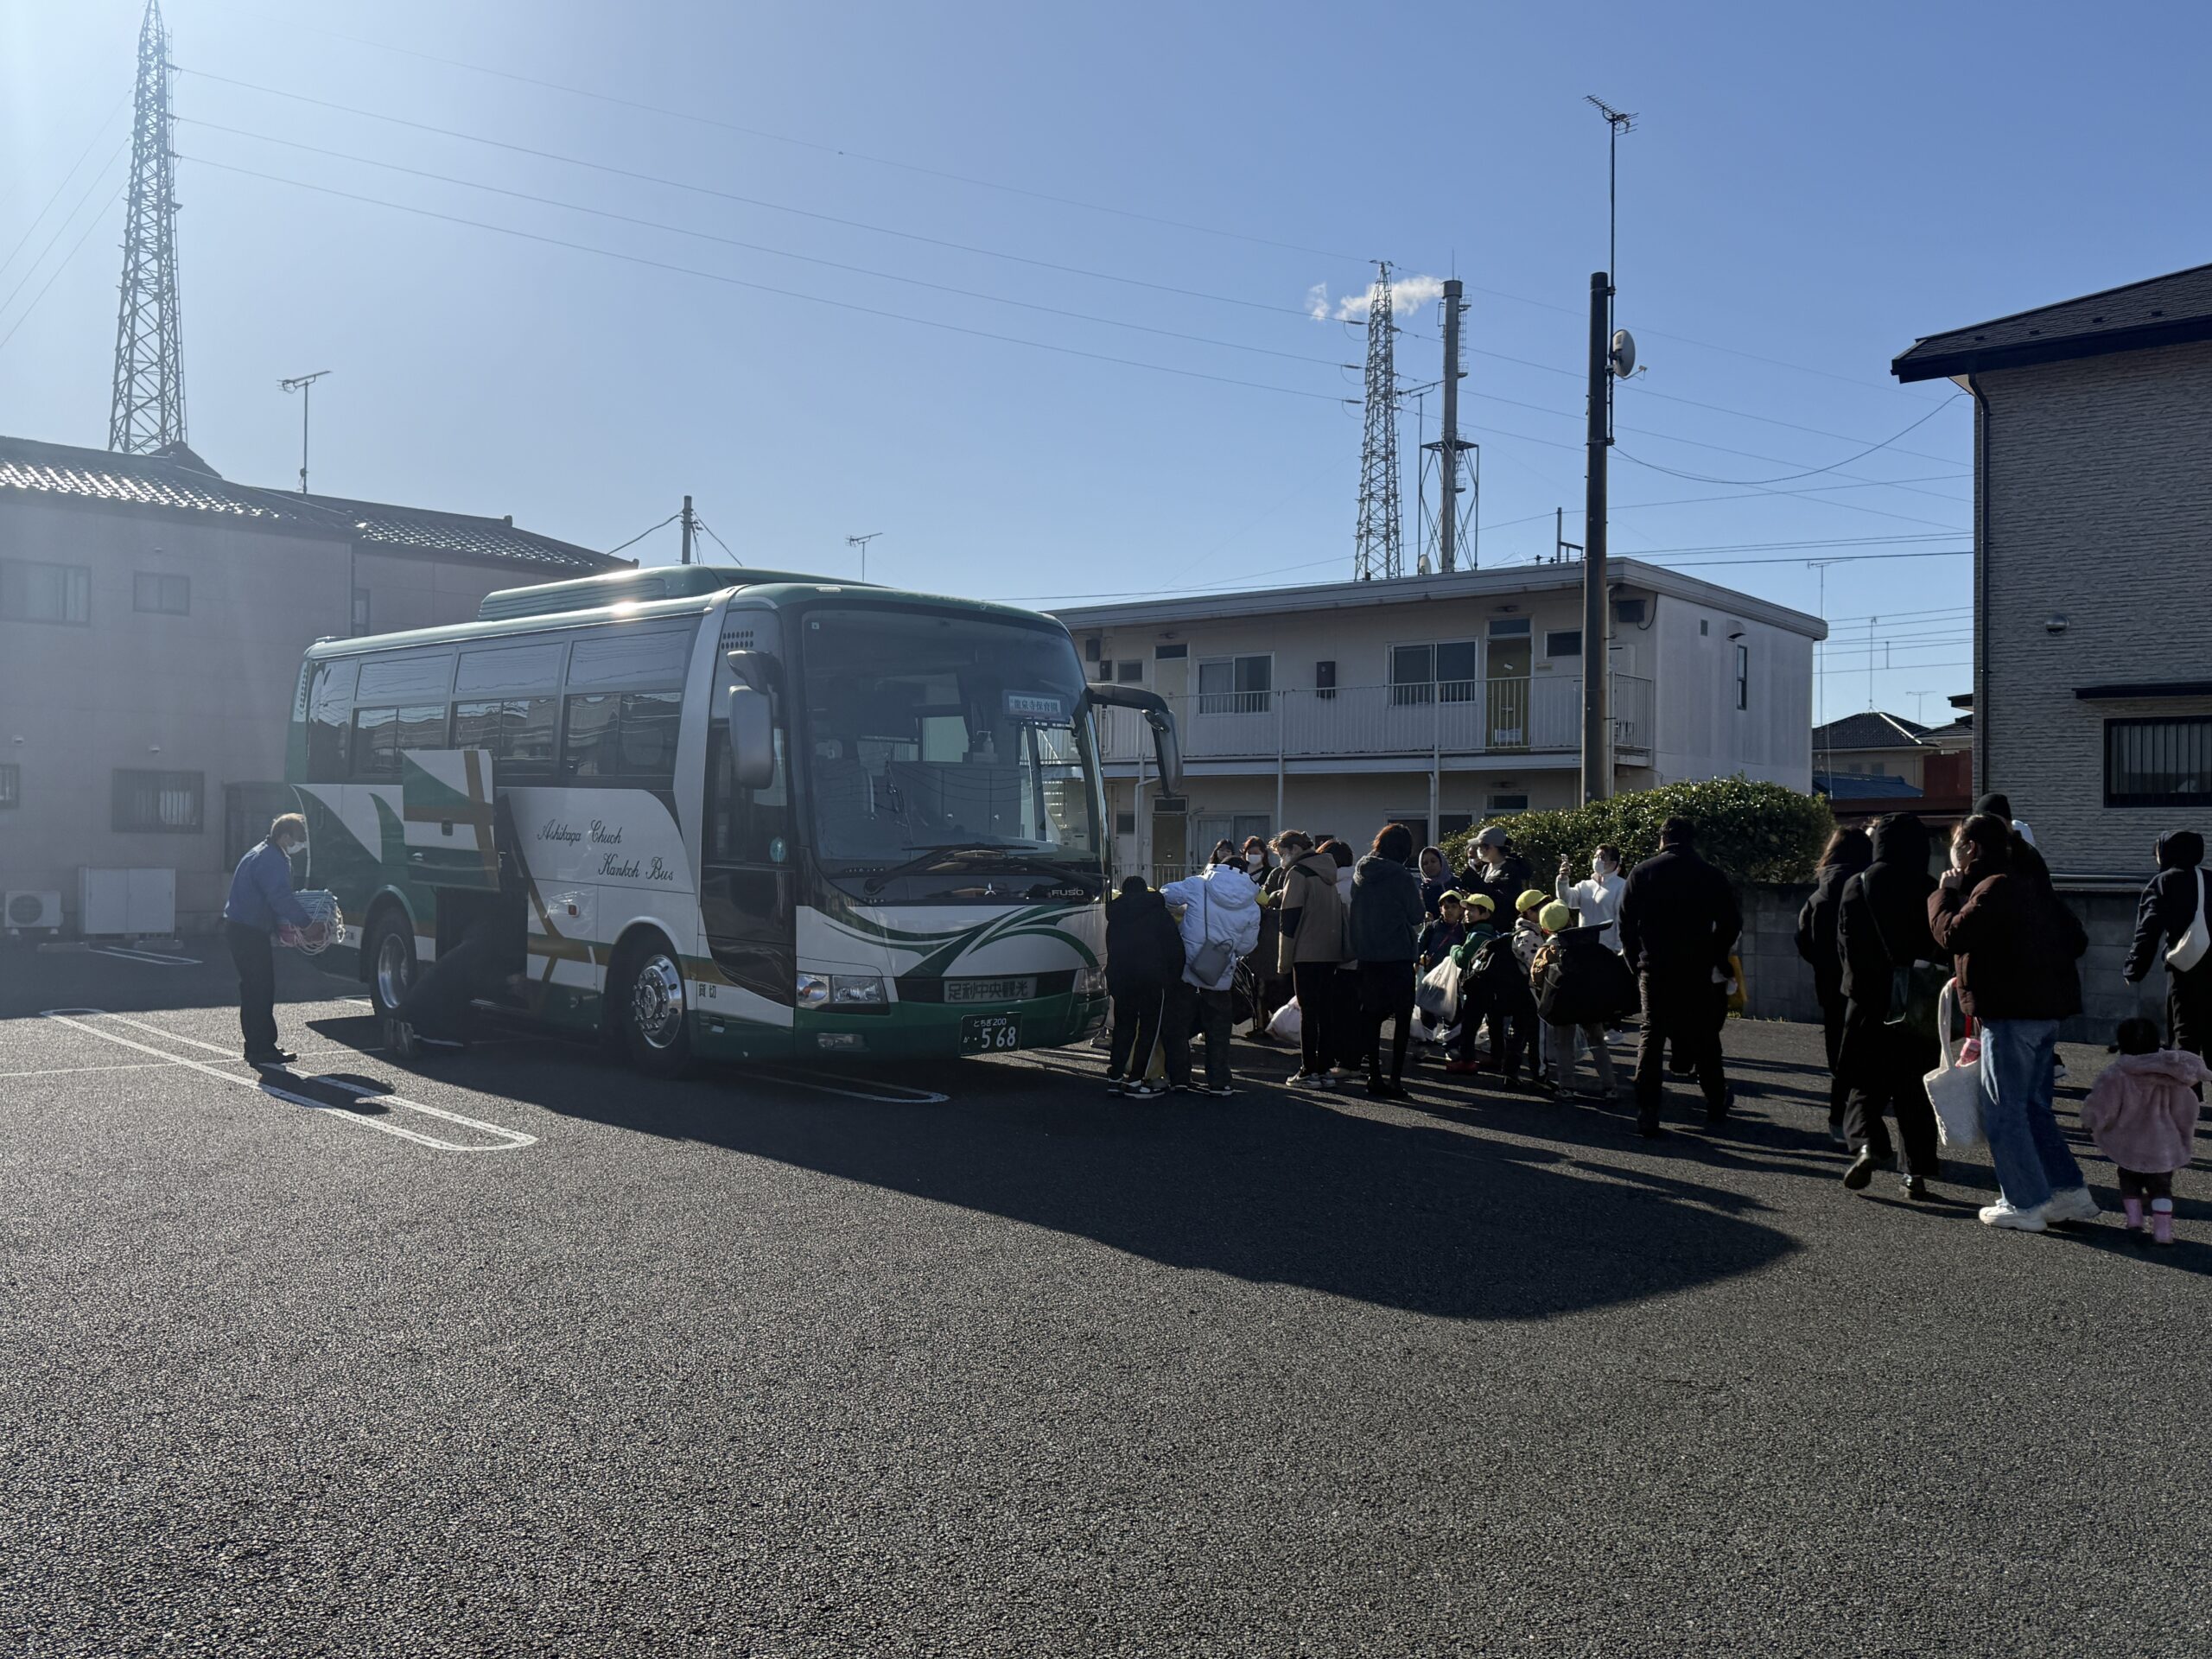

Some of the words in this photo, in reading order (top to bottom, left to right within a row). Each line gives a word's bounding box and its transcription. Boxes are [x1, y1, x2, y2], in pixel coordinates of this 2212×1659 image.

[537, 819, 582, 847] Ashikaga
[598, 852, 640, 878] Kankoh
[645, 856, 674, 881] Bus
[698, 983, 716, 999] 貸切
